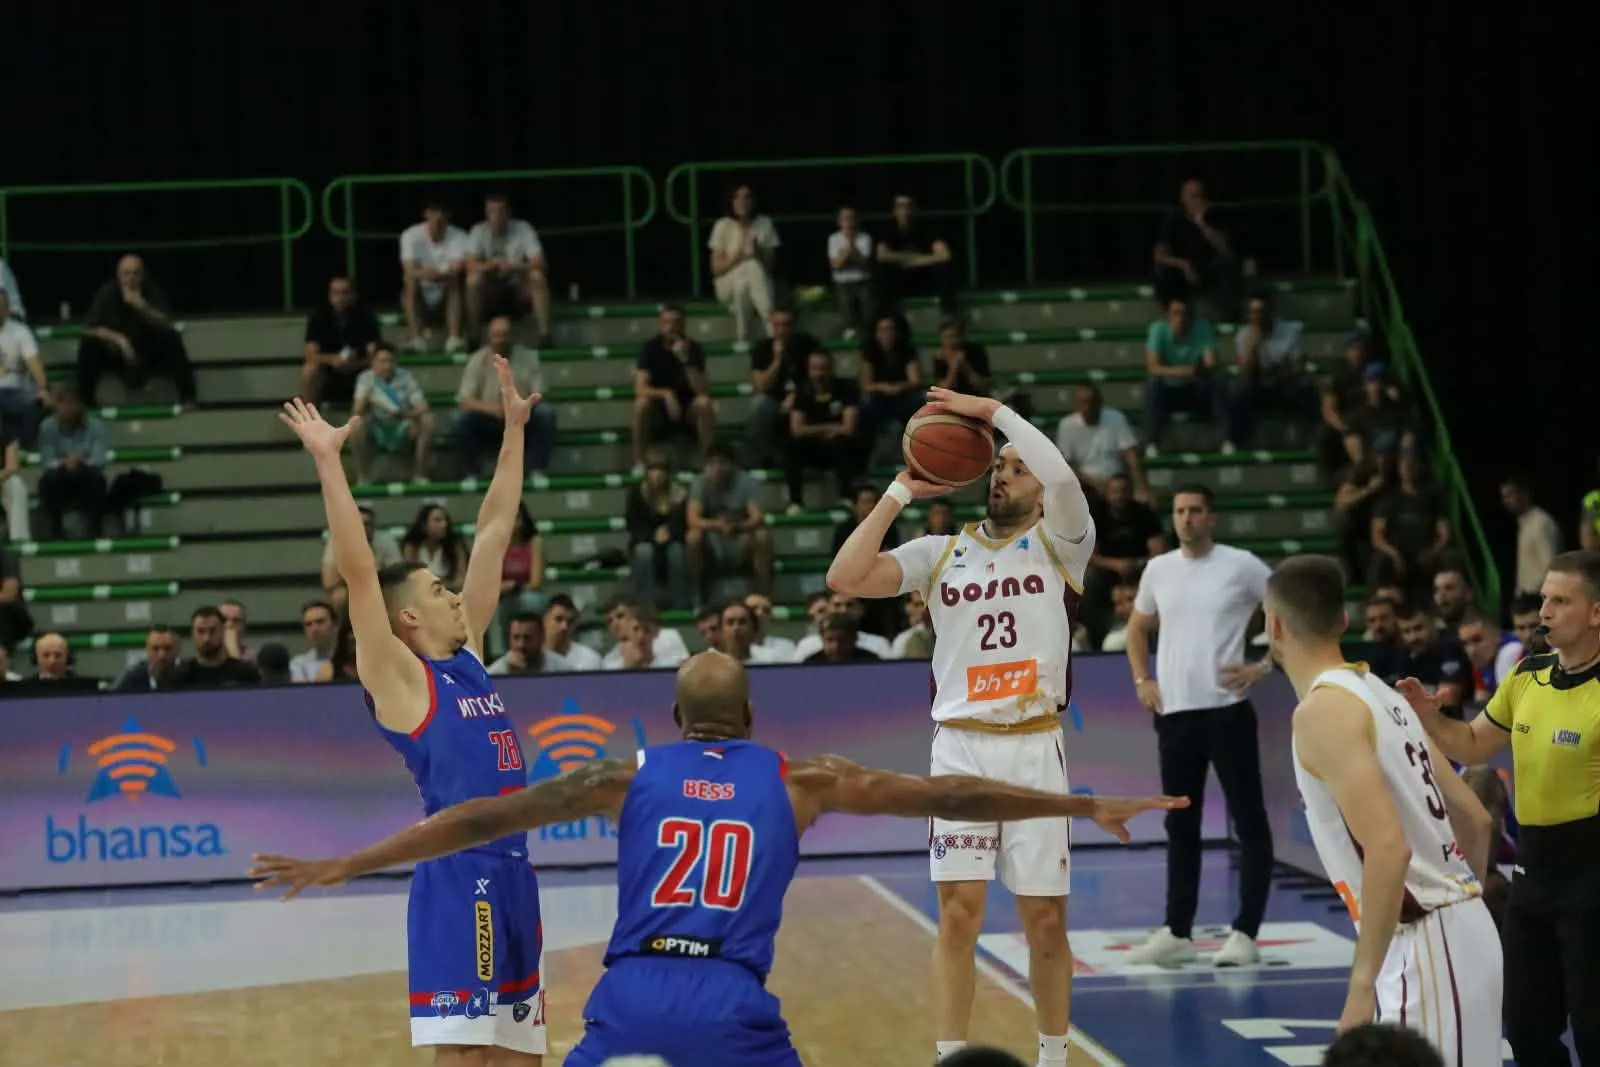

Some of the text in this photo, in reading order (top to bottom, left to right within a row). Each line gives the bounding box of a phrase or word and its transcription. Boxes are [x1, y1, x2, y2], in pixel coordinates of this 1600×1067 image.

[940, 574, 1045, 607] bosna
[977, 611, 1017, 651] 23
[488, 729, 522, 771] 28
[683, 779, 735, 800] BESS
[46, 813, 227, 863] bhansa
[651, 817, 754, 912] 20
[477, 904, 491, 977] MOZZART
[652, 937, 709, 956] OPTIM
